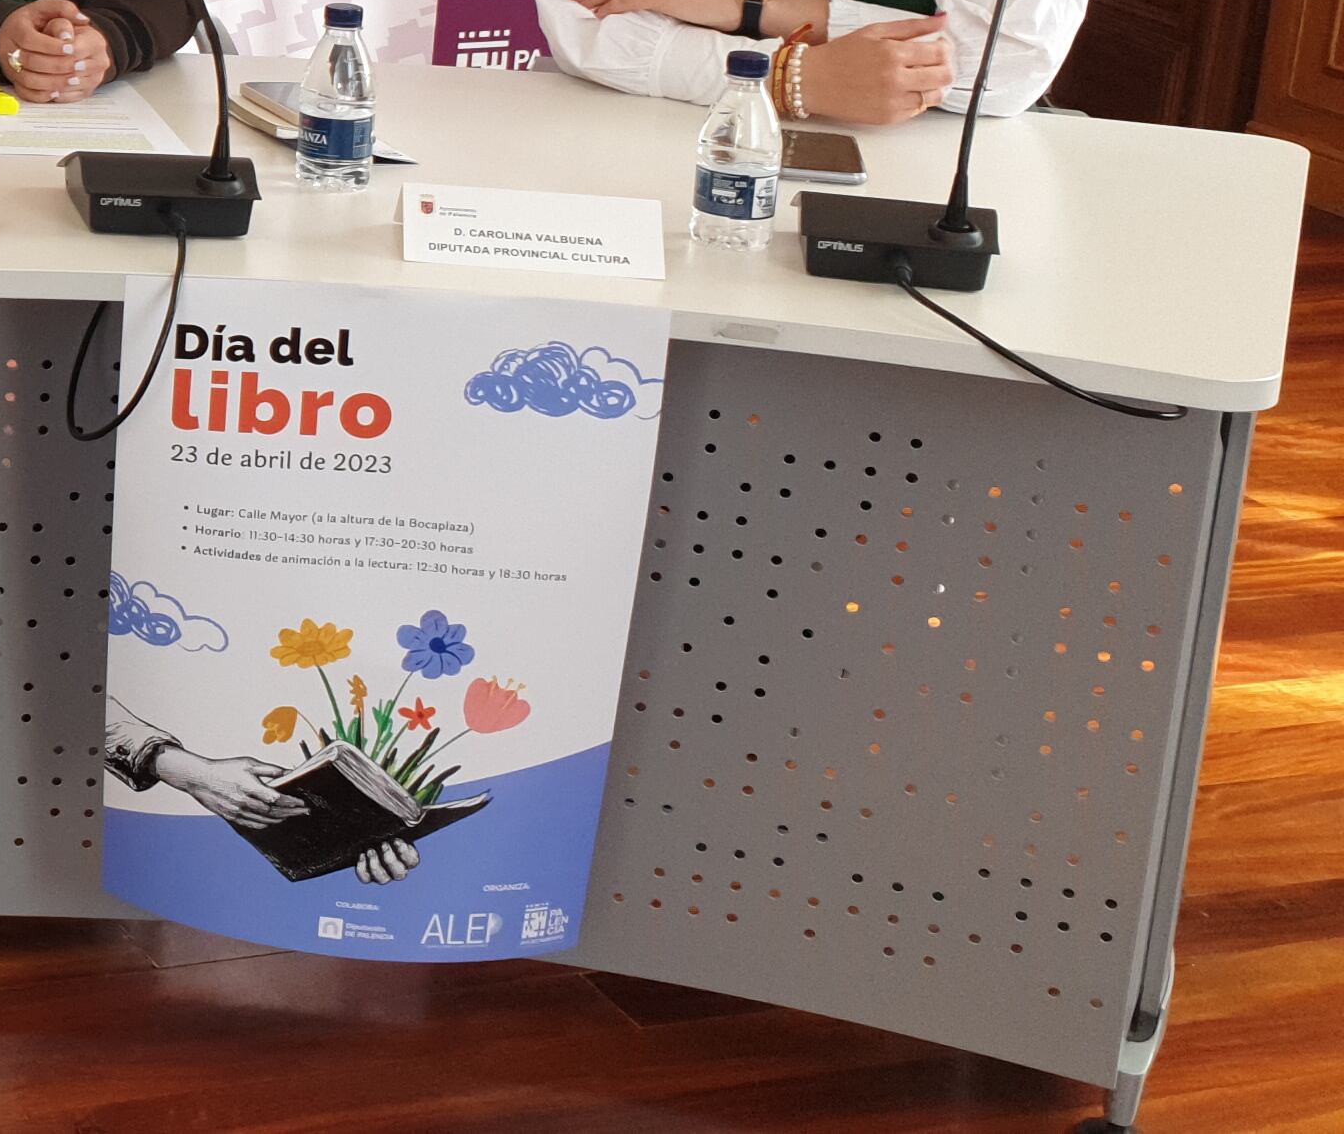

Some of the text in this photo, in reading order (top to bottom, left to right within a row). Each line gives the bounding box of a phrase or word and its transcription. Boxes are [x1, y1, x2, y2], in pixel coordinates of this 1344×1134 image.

[100, 197, 142, 207] OPTIMUS
[454, 228, 602, 246] D. CAROLINA VALBUENA
[817, 240, 863, 253] OPTIMUS
[428, 242, 630, 264] DIPUTADA PROVINCIAL CULTURA
[174, 324, 354, 366] Día del
[171, 369, 392, 439] libro
[171, 444, 392, 474] 23 de abril de 2023
[197, 505, 475, 535] Lugar: Calle Mayor (a la altura de la Bocaplaza)
[318, 535, 350, 545] horas
[354, 537, 361, 548] y
[440, 542, 474, 554] horas
[194, 546, 261, 561] Actividades
[265, 554, 278, 563] de
[281, 555, 340, 566] animación
[355, 558, 364, 567] la
[368, 559, 412, 570] lectura:
[417, 562, 448, 574] 12:30
[451, 565, 484, 577] horas
[489, 569, 495, 579] y
[534, 571, 567, 582] horas
